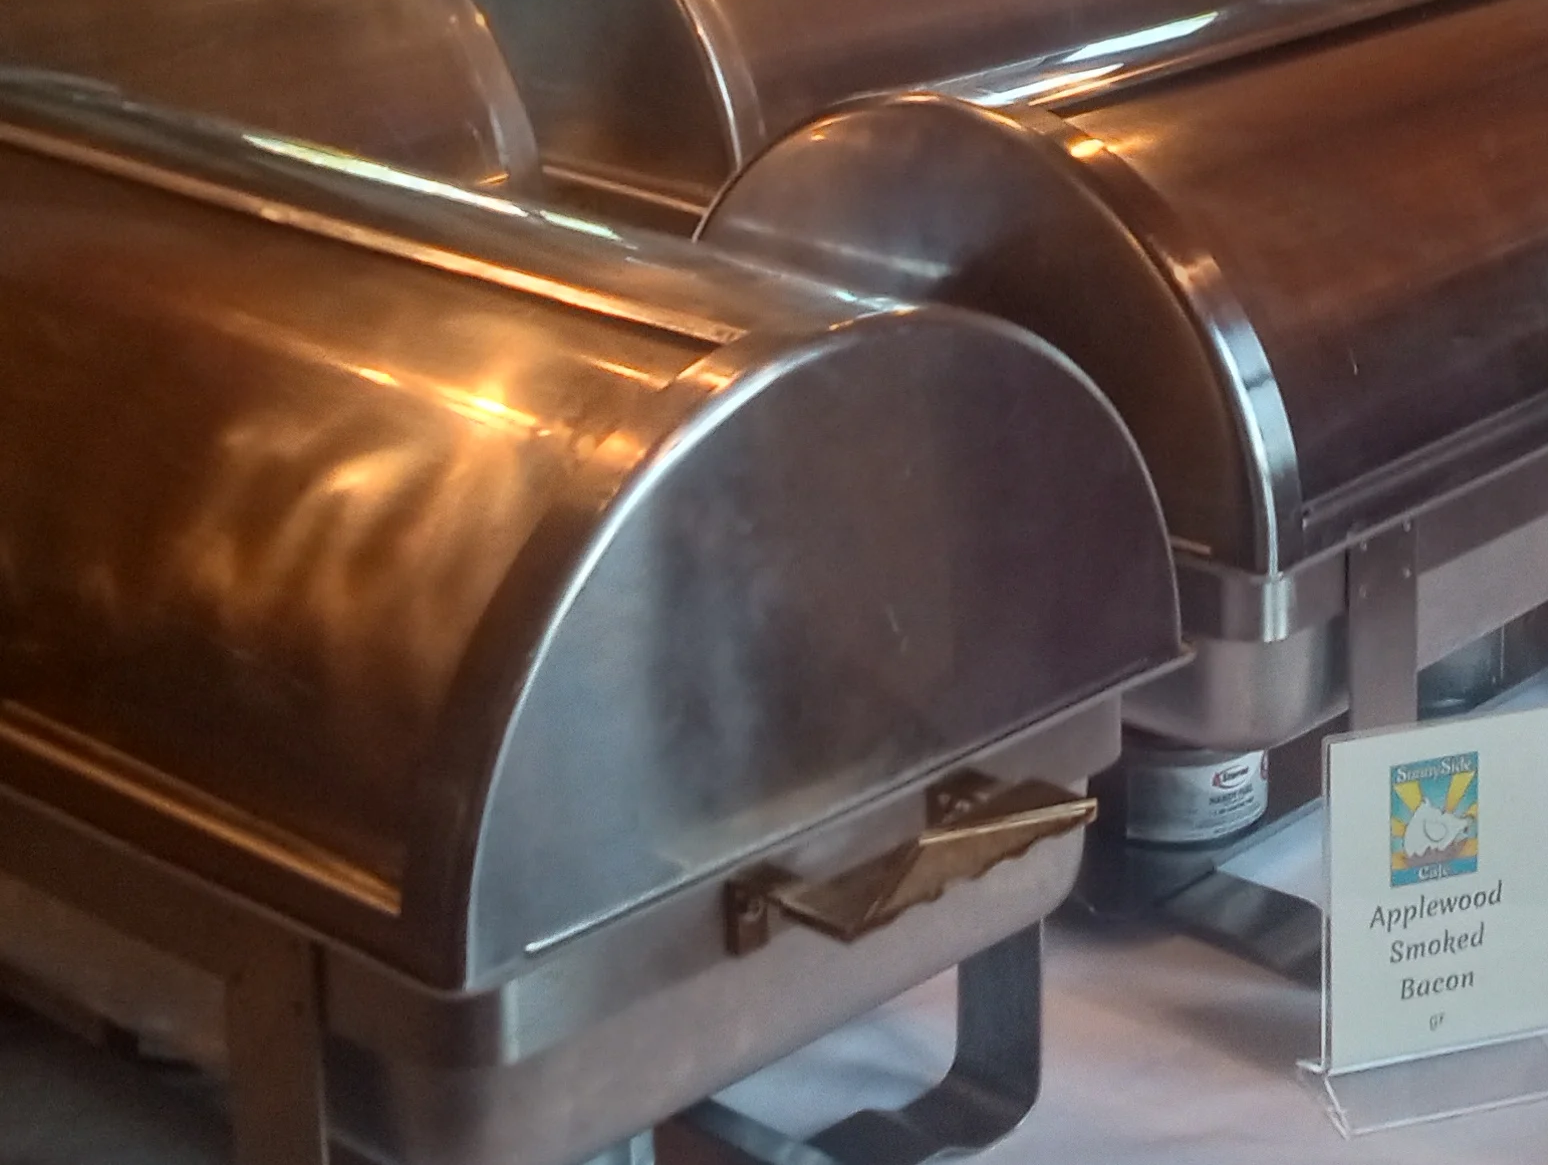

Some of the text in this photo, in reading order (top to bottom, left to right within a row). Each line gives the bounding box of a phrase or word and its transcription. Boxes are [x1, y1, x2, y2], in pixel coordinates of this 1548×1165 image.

[1369, 879, 1503, 933] Applewood
[1389, 921, 1485, 964] Smoked
[1400, 970, 1475, 1001] Bacon
